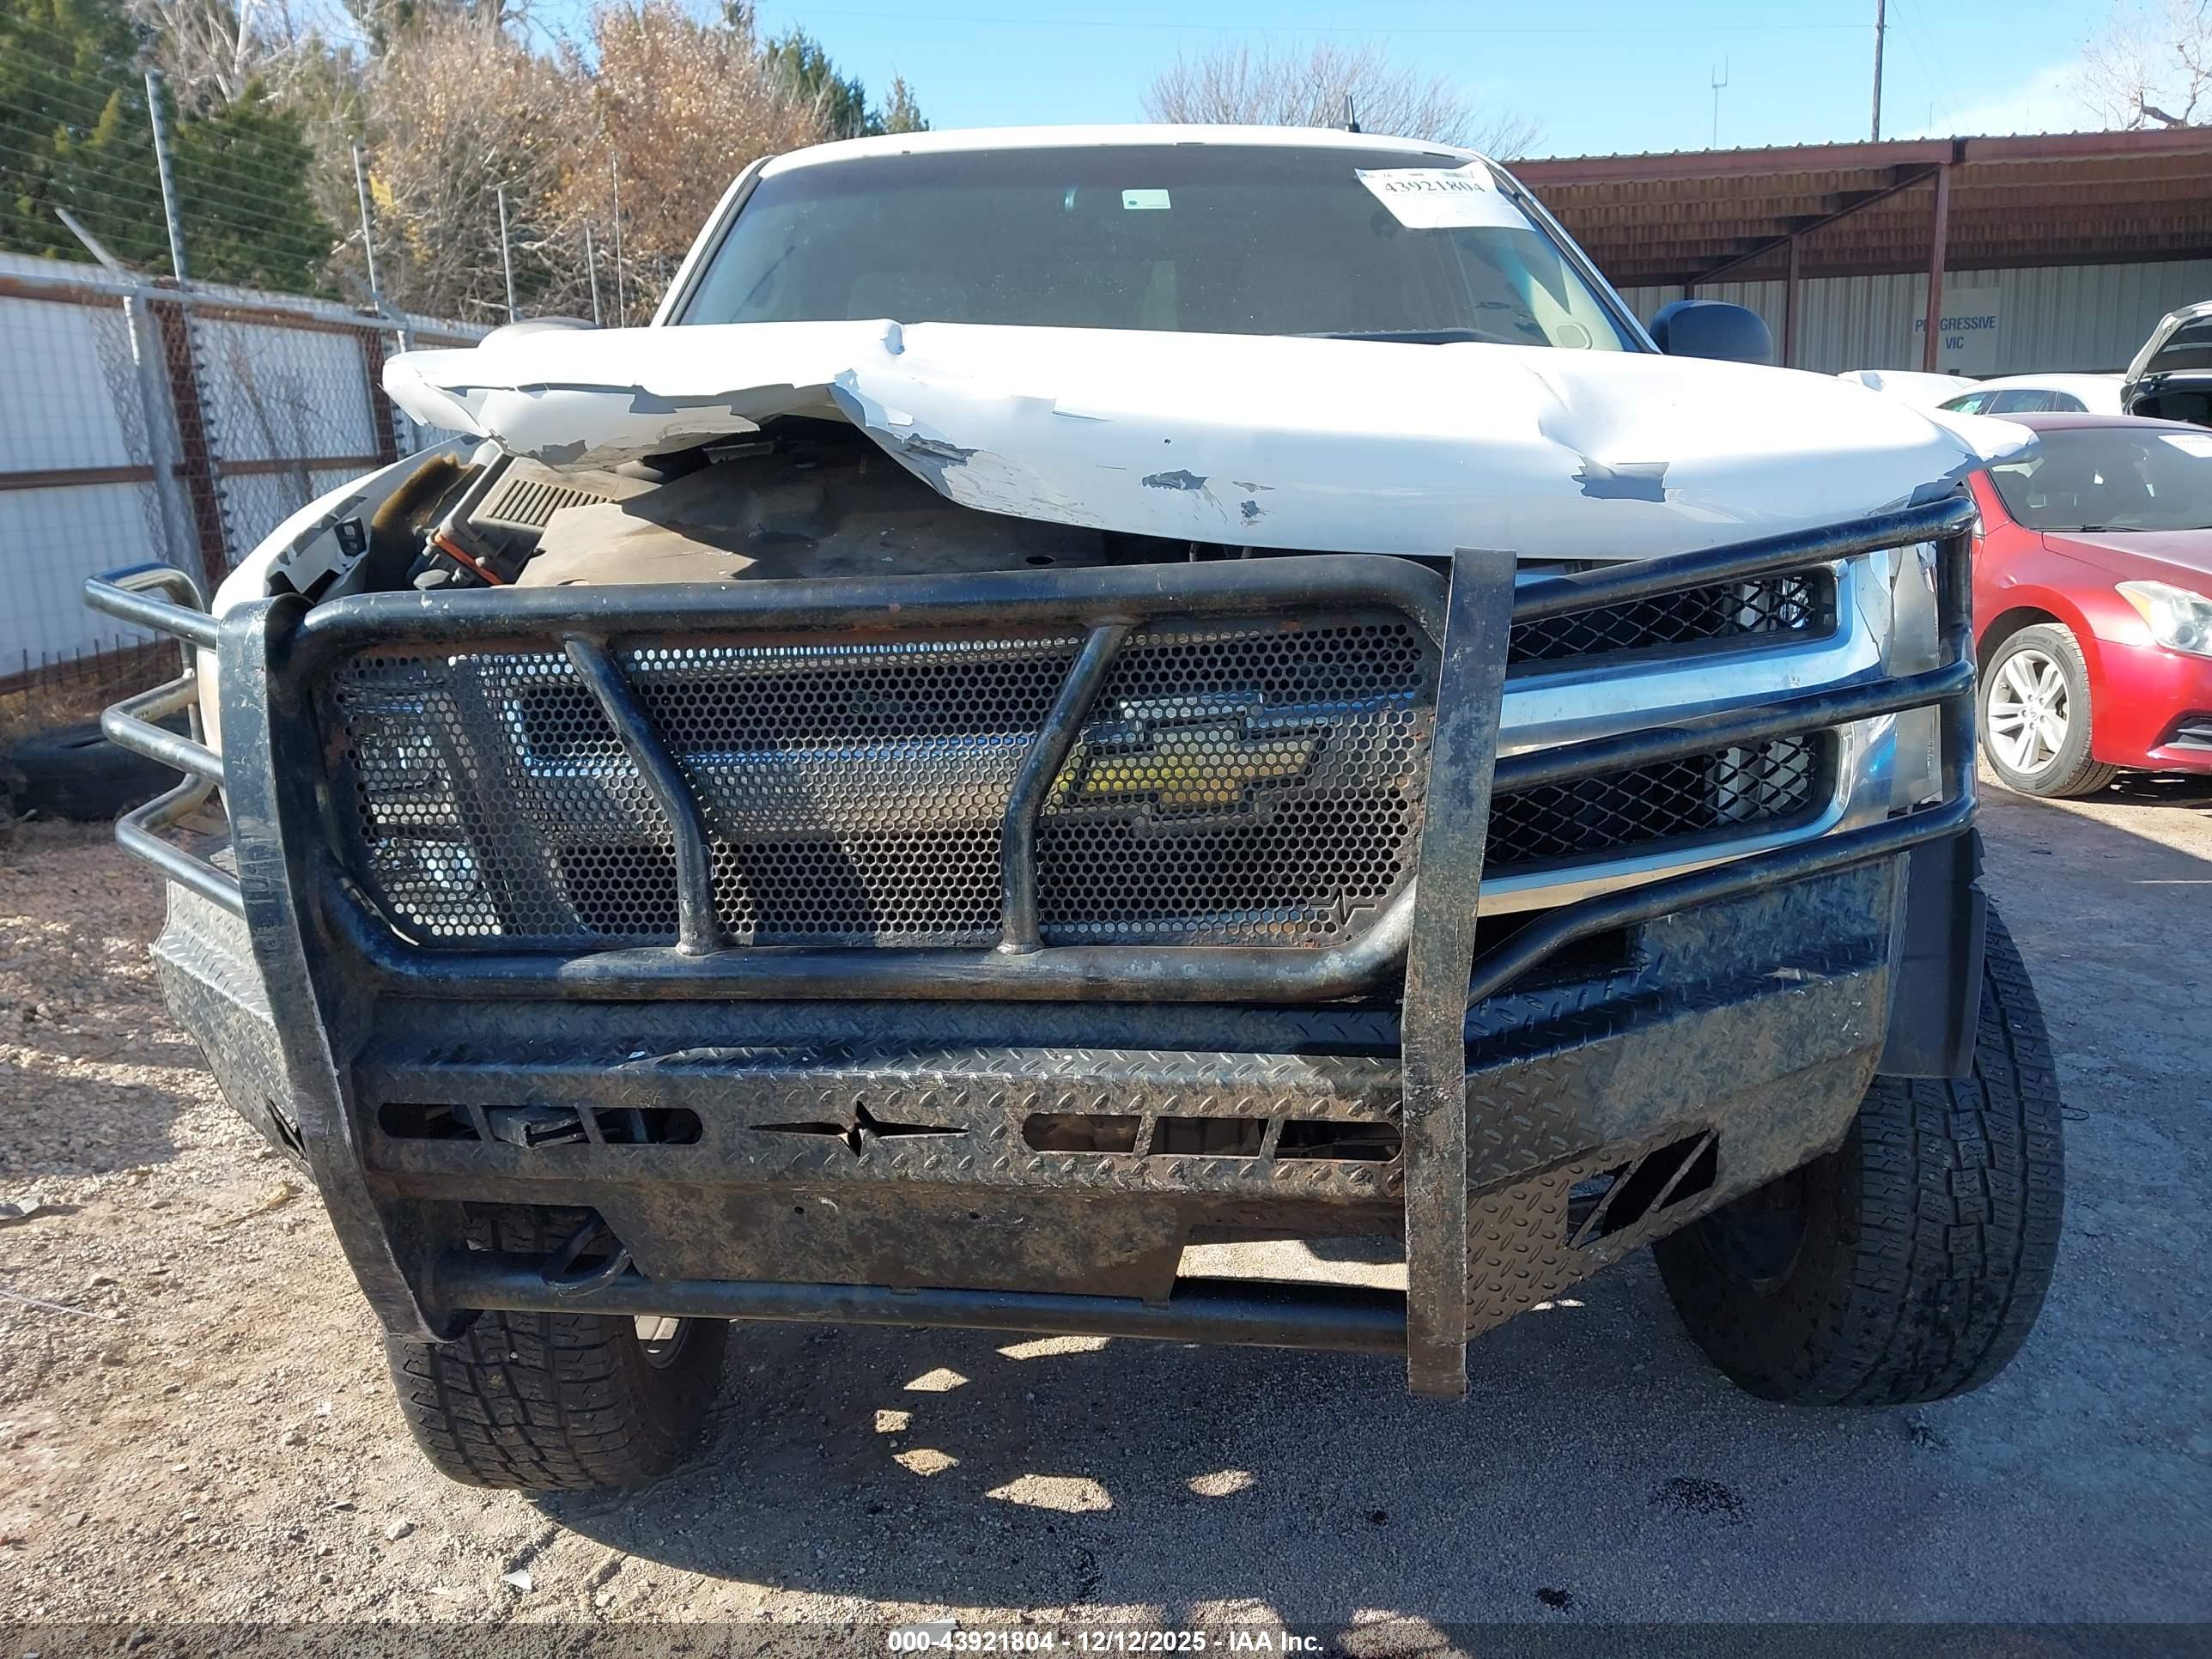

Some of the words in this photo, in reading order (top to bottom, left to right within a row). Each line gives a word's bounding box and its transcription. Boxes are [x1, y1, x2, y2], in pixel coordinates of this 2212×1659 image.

[1384, 180, 1486, 193] 43921804
[1915, 316, 1996, 332] PGRESSIVE
[1945, 337, 1964, 349] VIC
